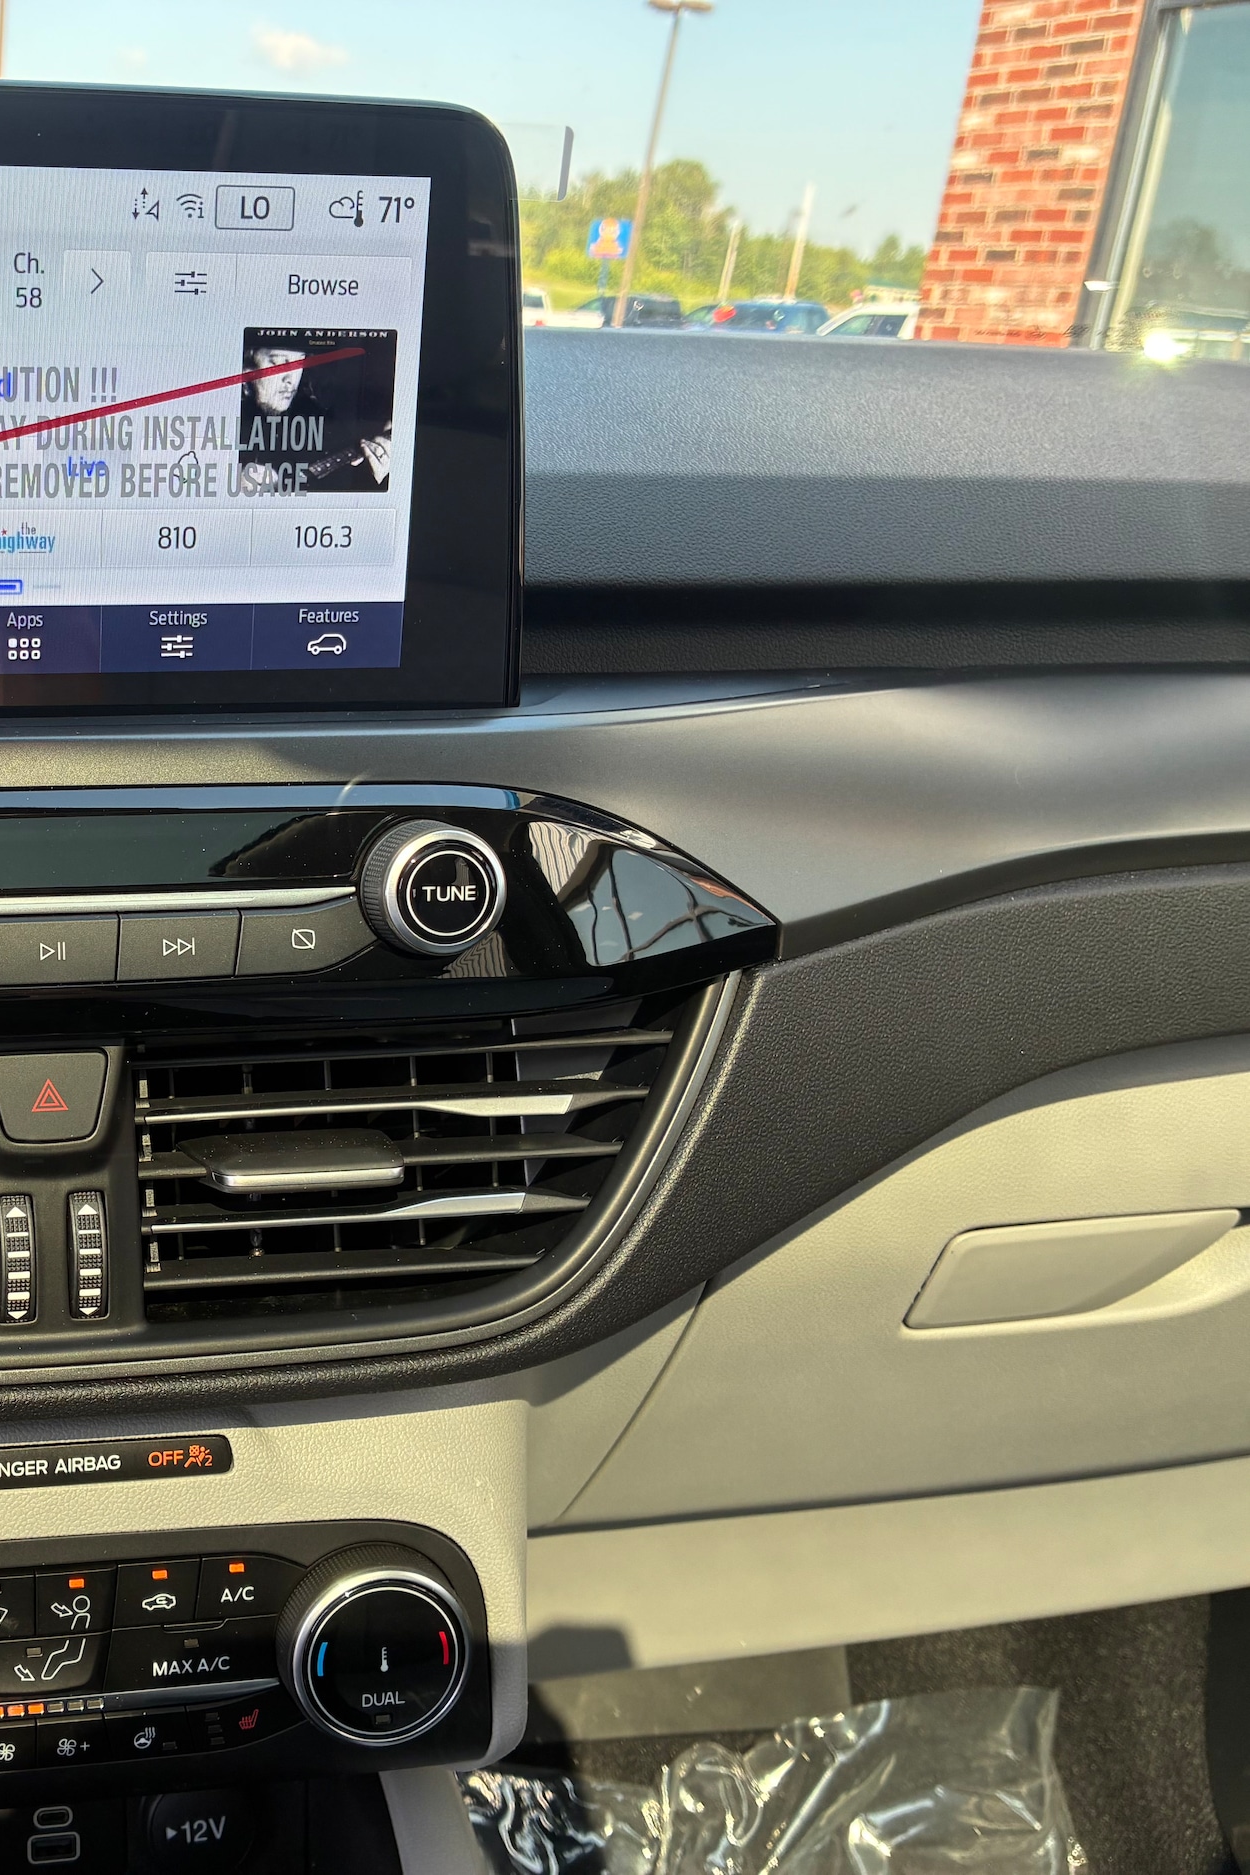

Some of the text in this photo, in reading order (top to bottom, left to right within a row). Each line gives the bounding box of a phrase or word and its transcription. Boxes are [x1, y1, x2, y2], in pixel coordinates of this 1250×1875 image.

[240, 196, 270, 221] LO
[379, 196, 415, 224] 71°
[13, 252, 45, 274] Ch.
[288, 274, 359, 296] Browse
[15, 287, 43, 309] 58
[304, 330, 389, 338] ANDERSON
[90, 367, 118, 403] !!!
[37, 414, 133, 451] DURING
[143, 415, 324, 451] INSTALLATION
[68, 456, 106, 477] Live
[120, 463, 218, 498] BEFORE
[227, 462, 308, 498] USAGE
[21, 522, 37, 535] the
[158, 526, 197, 549] 810
[295, 525, 353, 549] 106.3
[6, 611, 44, 630] Apps
[149, 610, 208, 628] Settings
[298, 608, 360, 625] Features
[421, 884, 477, 902] TUNE
[54, 1454, 122, 1474] AIRBAG
[148, 1449, 184, 1467] OFF
[220, 1585, 255, 1603] A/C
[152, 1655, 231, 1677] MAX A/C
[361, 1692, 406, 1709] DUAL
[180, 1815, 227, 1845] 12V
